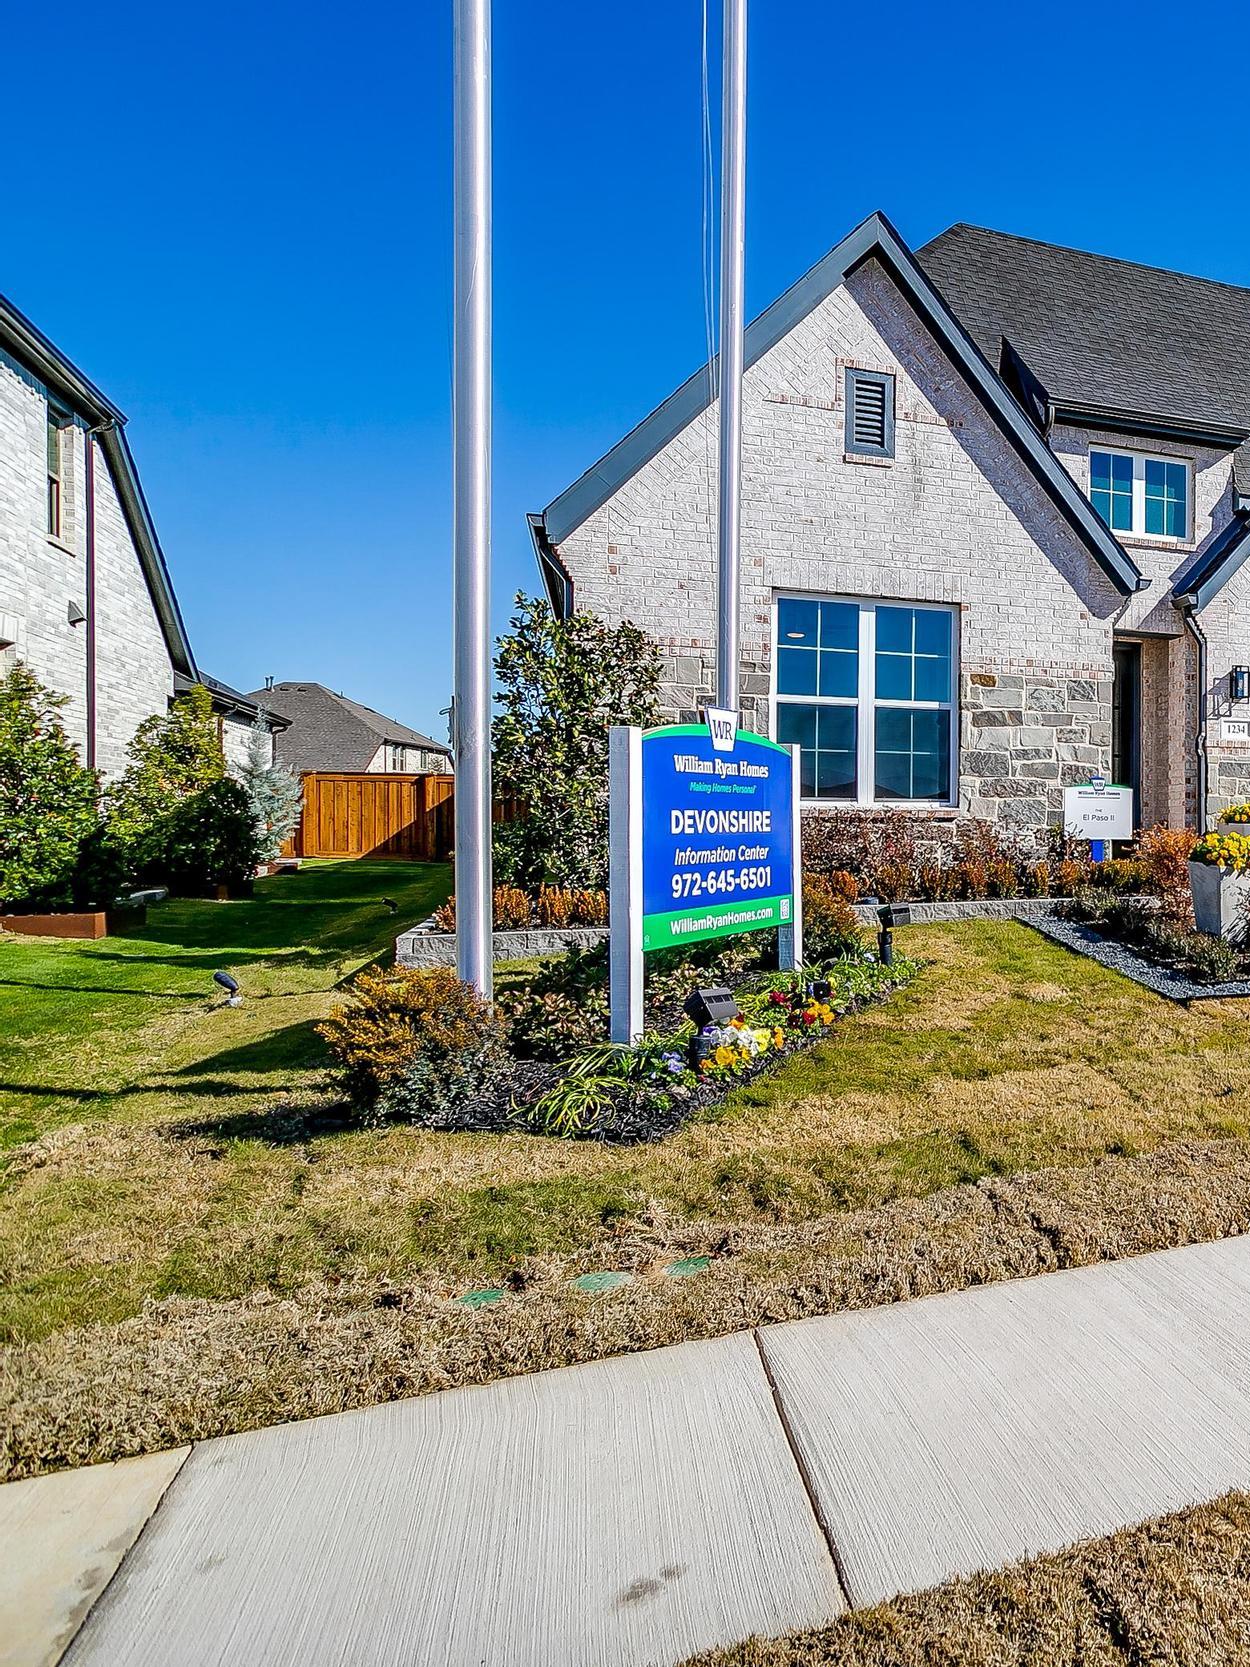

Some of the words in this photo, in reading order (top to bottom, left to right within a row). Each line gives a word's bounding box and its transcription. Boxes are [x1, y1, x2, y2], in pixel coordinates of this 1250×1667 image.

[712, 719, 733, 741] WR
[1227, 724, 1245, 734] 1234
[673, 754, 714, 774] William
[714, 758, 738, 779] Ryan
[739, 760, 769, 778] Homes
[689, 781, 712, 794] Making
[712, 782, 732, 793] Homes
[732, 784, 757, 794] Personal
[671, 809, 772, 834] DEVONSHIRE
[674, 845, 736, 866] Information
[738, 844, 770, 861] Center
[671, 866, 771, 899] 972-645-6501
[670, 907, 773, 935] WilliamRyanHomes.com
